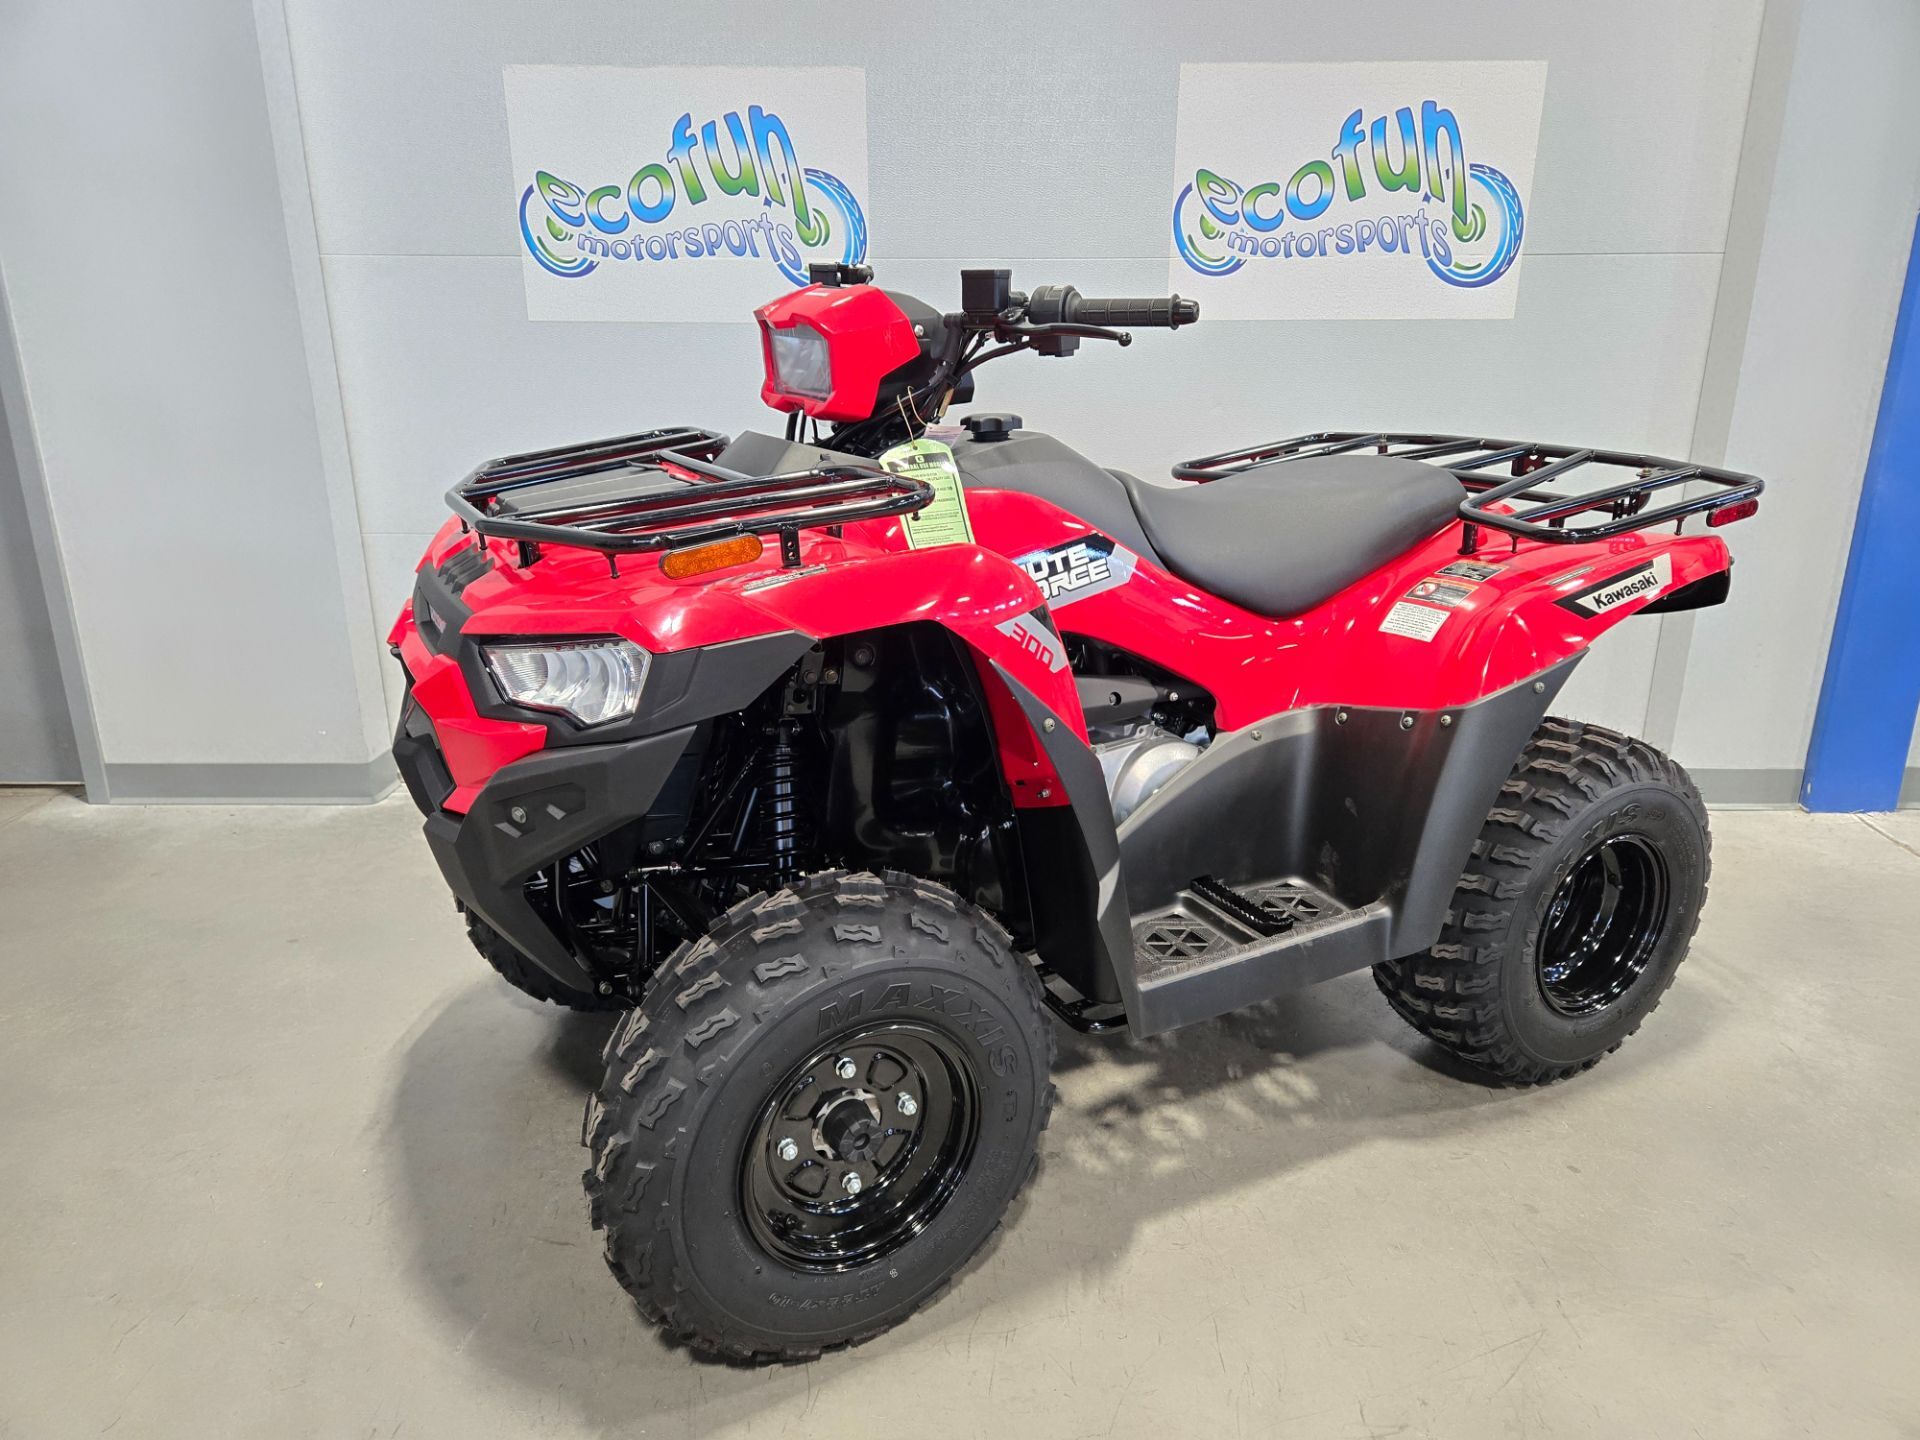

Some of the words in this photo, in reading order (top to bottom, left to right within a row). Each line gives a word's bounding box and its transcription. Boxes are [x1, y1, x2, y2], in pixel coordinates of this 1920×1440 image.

[536, 105, 811, 230] ecofun
[1196, 100, 1468, 225] ecofun
[577, 212, 802, 271] motorsports
[1227, 208, 1453, 268] motorsports
[1020, 543, 1090, 582] UTE
[1036, 557, 1111, 600] ORCE
[1592, 571, 1659, 610] Kawasaki
[1009, 622, 1055, 669] 300
[817, 982, 1018, 1077] MAXXIS
